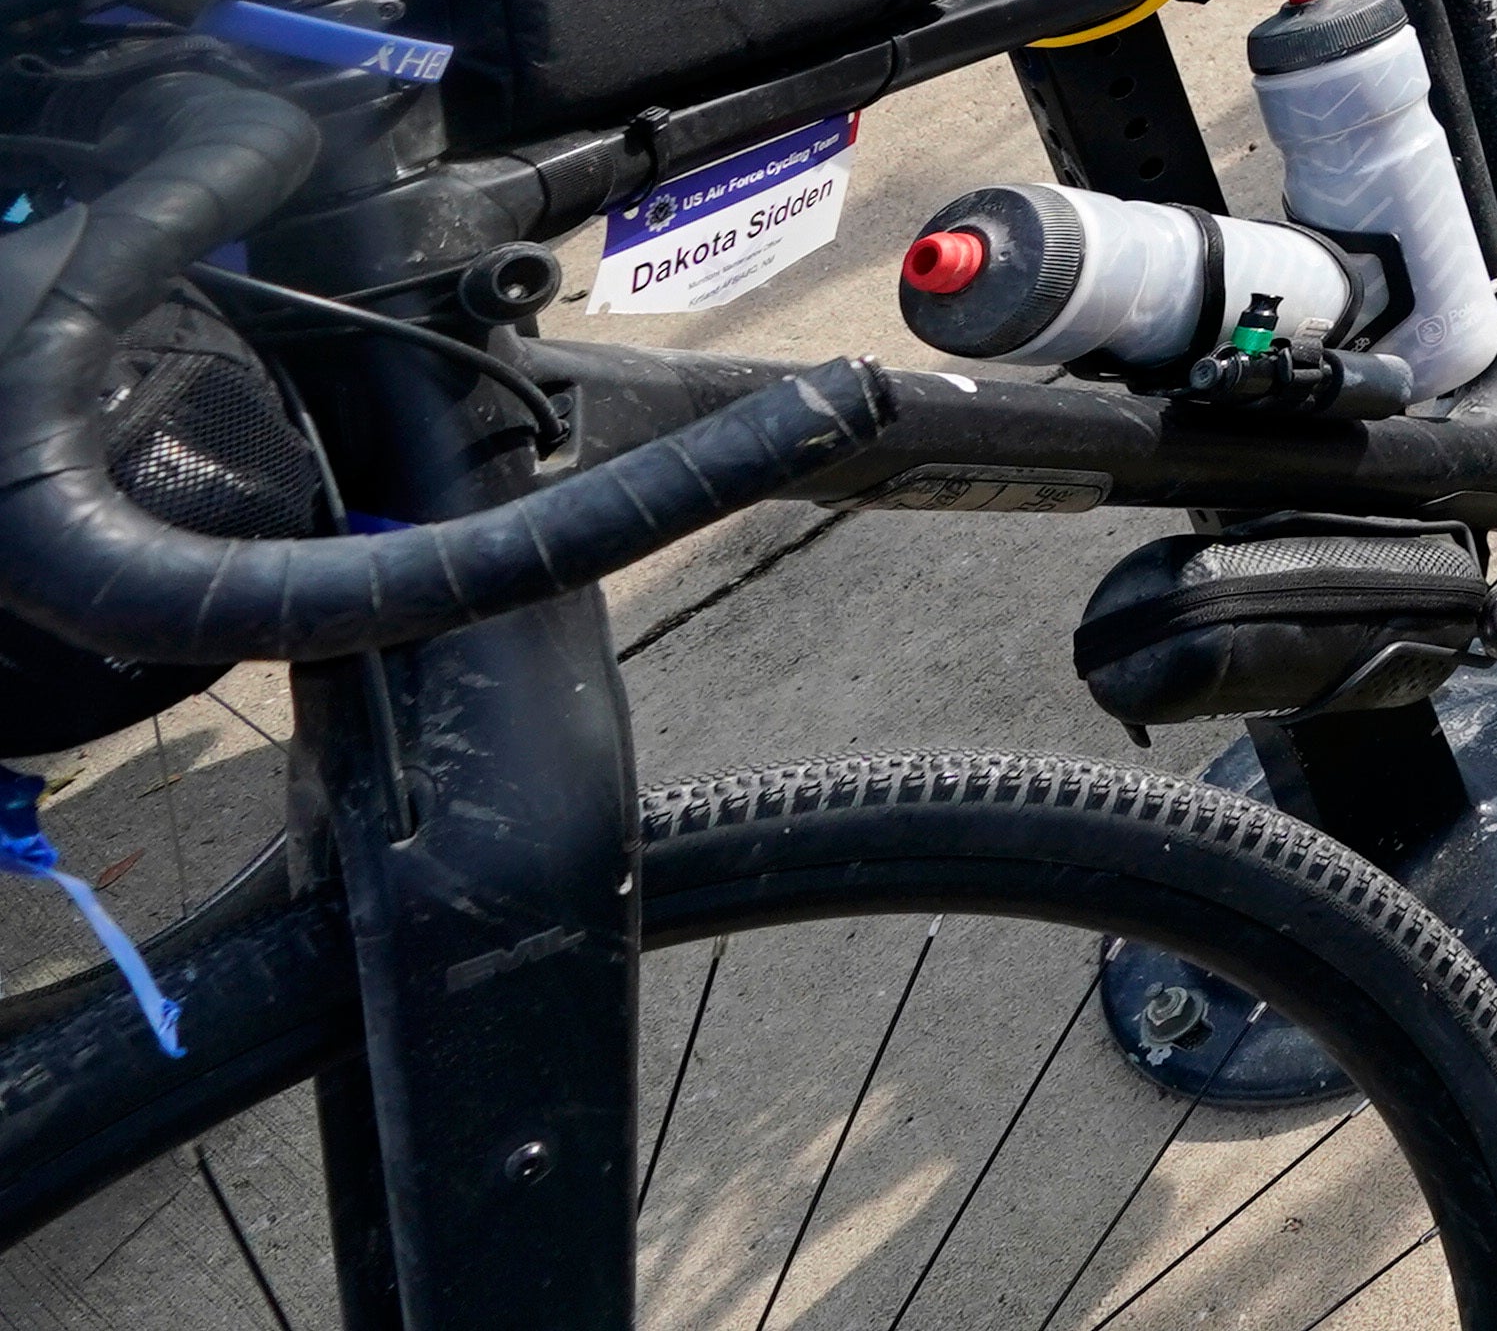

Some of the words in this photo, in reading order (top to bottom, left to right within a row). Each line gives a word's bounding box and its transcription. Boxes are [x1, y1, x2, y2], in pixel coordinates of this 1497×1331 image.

[682, 191, 704, 213] US
[707, 184, 729, 206] Air
[730, 173, 764, 199] Force
[764, 153, 810, 190] Cycling
[808, 134, 841, 163] Team
[630, 225, 737, 296] Dakota
[747, 177, 834, 238] Sidden
